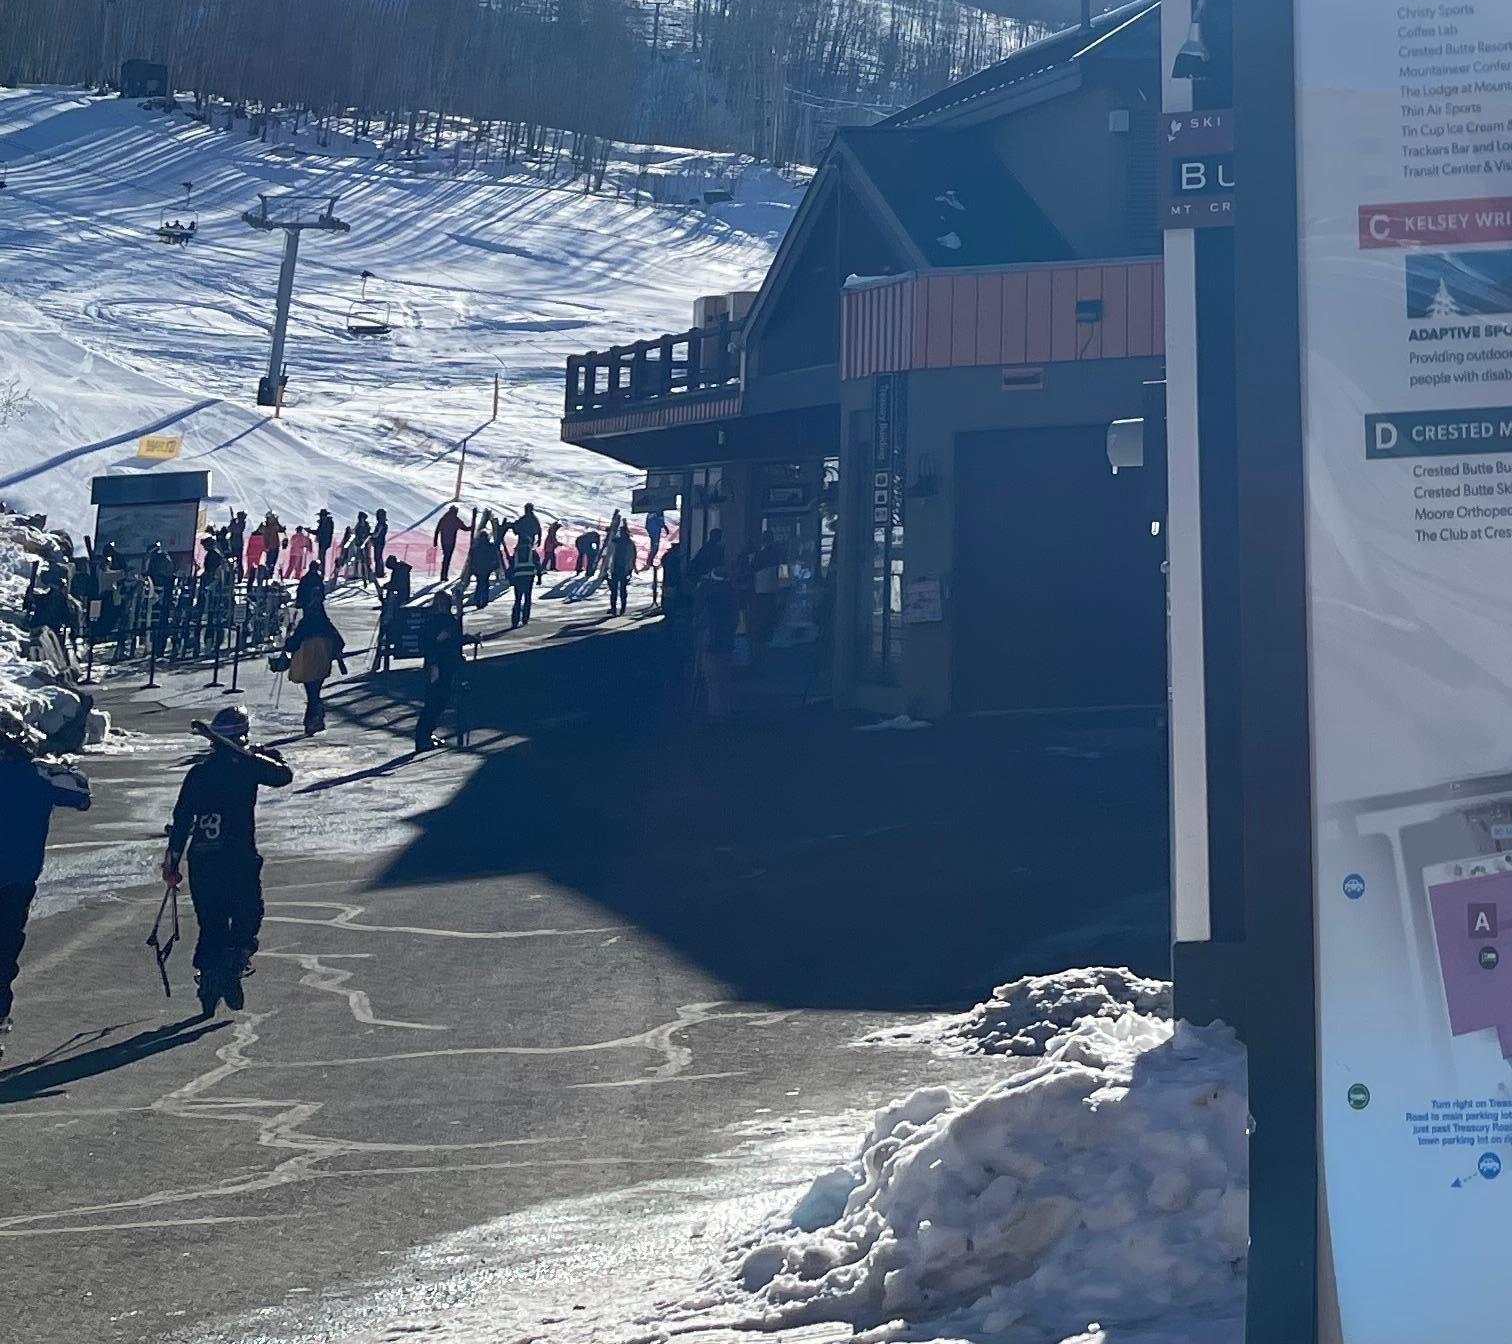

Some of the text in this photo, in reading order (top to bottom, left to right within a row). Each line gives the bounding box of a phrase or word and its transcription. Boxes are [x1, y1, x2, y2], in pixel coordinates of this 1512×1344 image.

[1190, 117, 1220, 128] SKI
[1401, 142, 1449, 159] Trackers
[1452, 141, 1469, 155] Bar
[1472, 140, 1494, 153] and
[1171, 205, 1191, 214] MT
[1368, 215, 1391, 240] C
[1404, 213, 1466, 232] KELSEY
[1408, 325, 1480, 342] ADAPTIVE
[1375, 423, 1397, 448] D
[1412, 422, 1493, 442] CRESTED
[1414, 507, 1453, 521] Moore
[1415, 529, 1437, 543] The
[1440, 528, 1468, 542] Club
[1470, 529, 1483, 540] at
[1474, 911, 1490, 931] A
